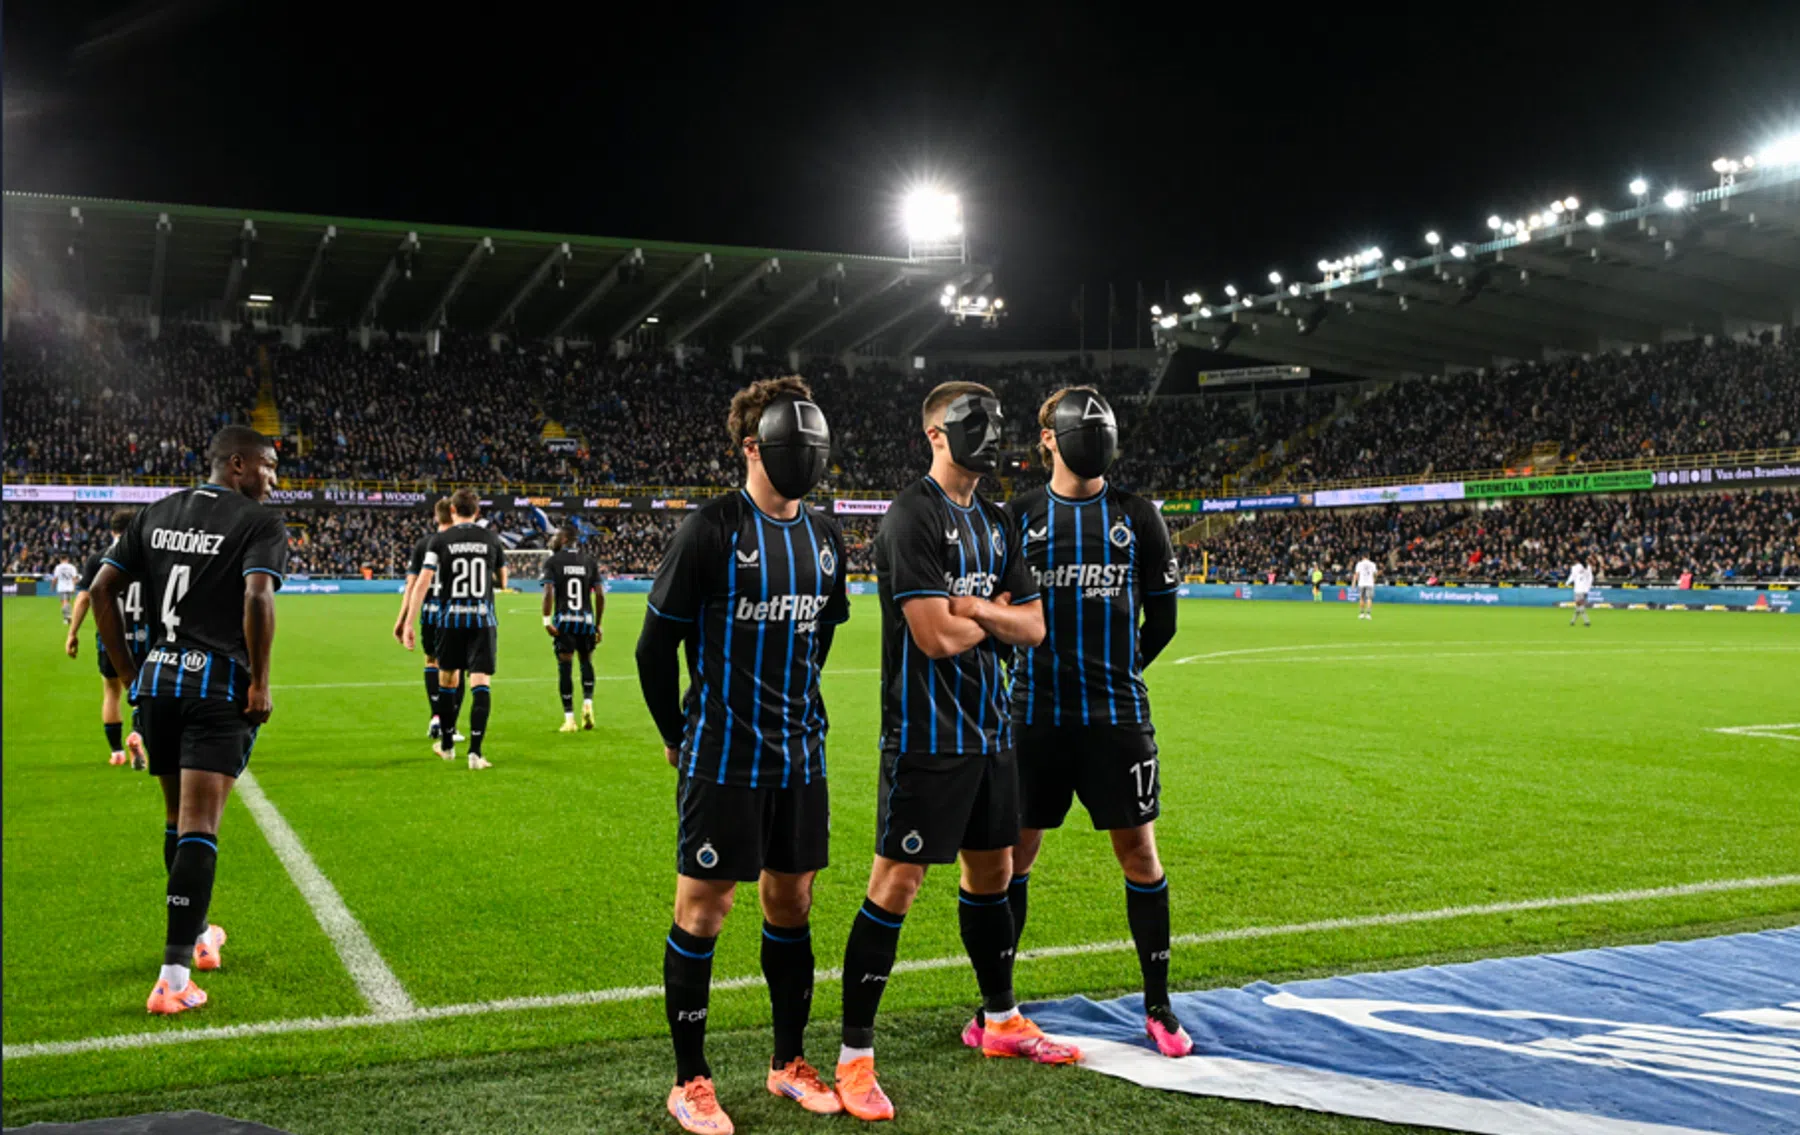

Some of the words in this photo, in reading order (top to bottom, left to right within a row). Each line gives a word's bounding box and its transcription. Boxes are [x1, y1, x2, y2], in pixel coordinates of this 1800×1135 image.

[77, 488, 113, 498] EVENT
[270, 490, 313, 500] WOODS
[384, 492, 426, 502] WOODS
[452, 557, 486, 598] 20
[567, 577, 583, 611] 9
[161, 564, 191, 643] 4
[1129, 758, 1157, 798] 17
